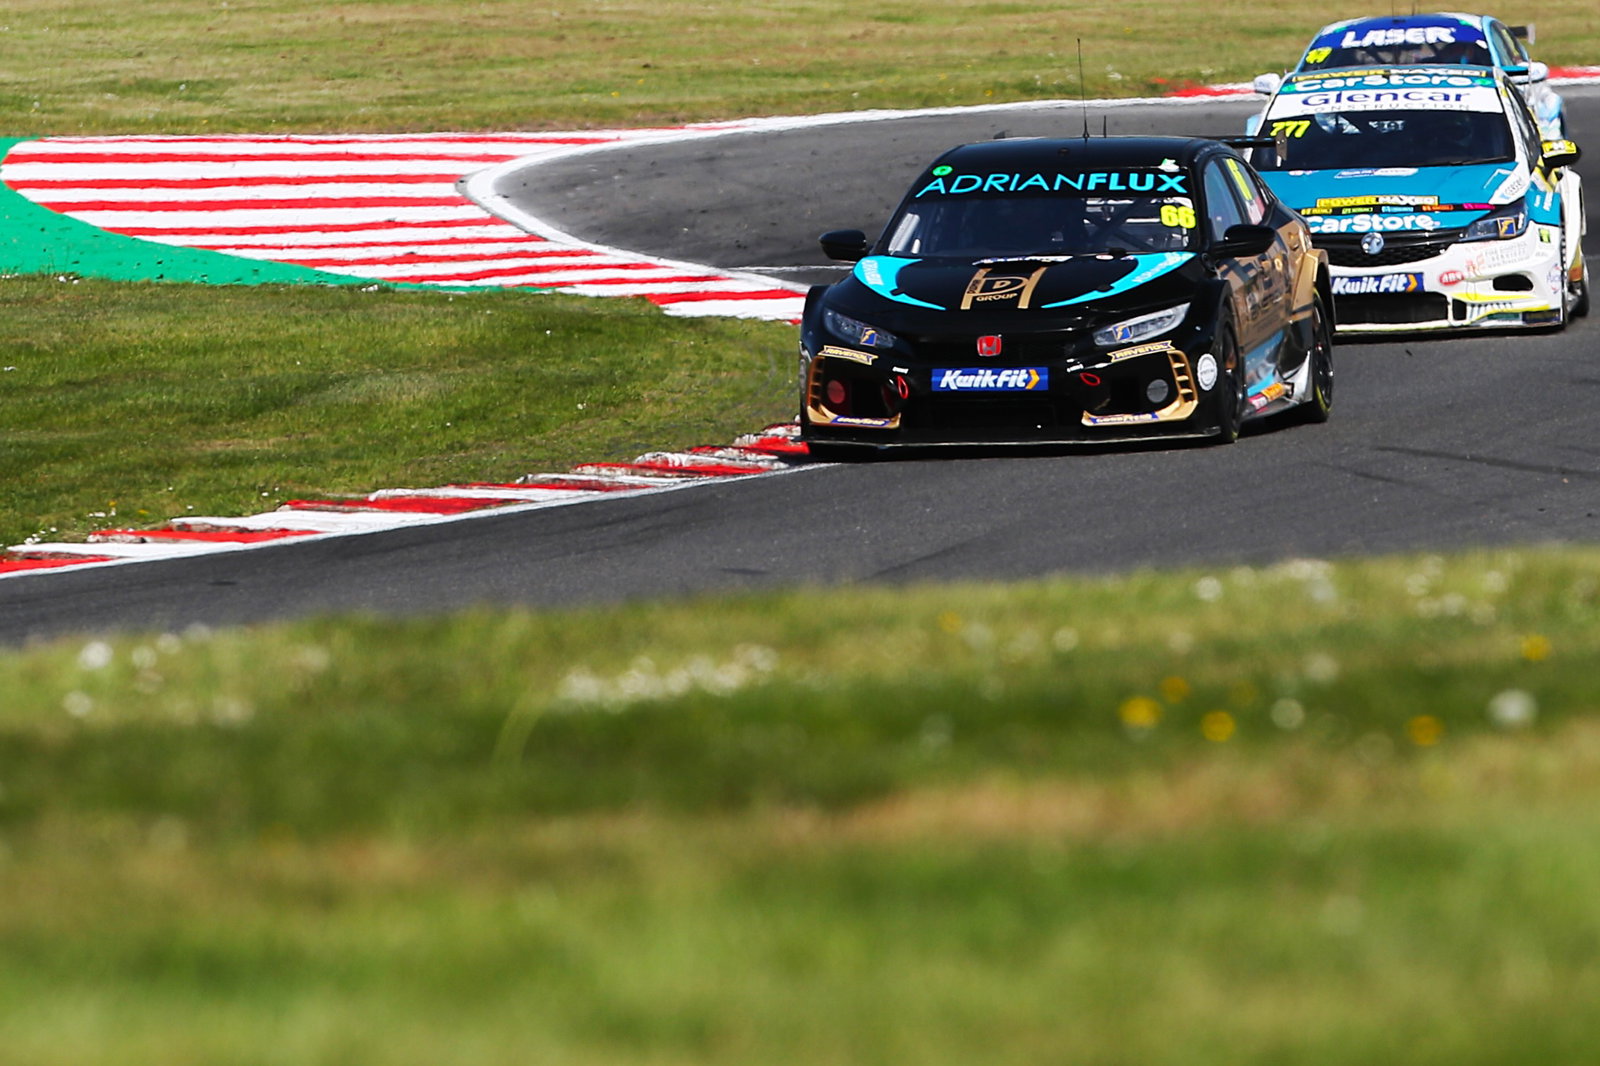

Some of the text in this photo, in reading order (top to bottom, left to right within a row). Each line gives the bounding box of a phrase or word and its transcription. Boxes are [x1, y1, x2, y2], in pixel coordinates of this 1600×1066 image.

[1341, 27, 1453, 48] LASER
[1295, 75, 1473, 91] CarStore
[1302, 91, 1470, 106] Glencar
[1270, 120, 1310, 138] 777
[915, 173, 1188, 197] ADRIANFLUX
[1319, 196, 1377, 207] POWER
[1160, 204, 1196, 228] 66
[1306, 213, 1434, 234] CarStore
[976, 293, 1018, 302] GROUP
